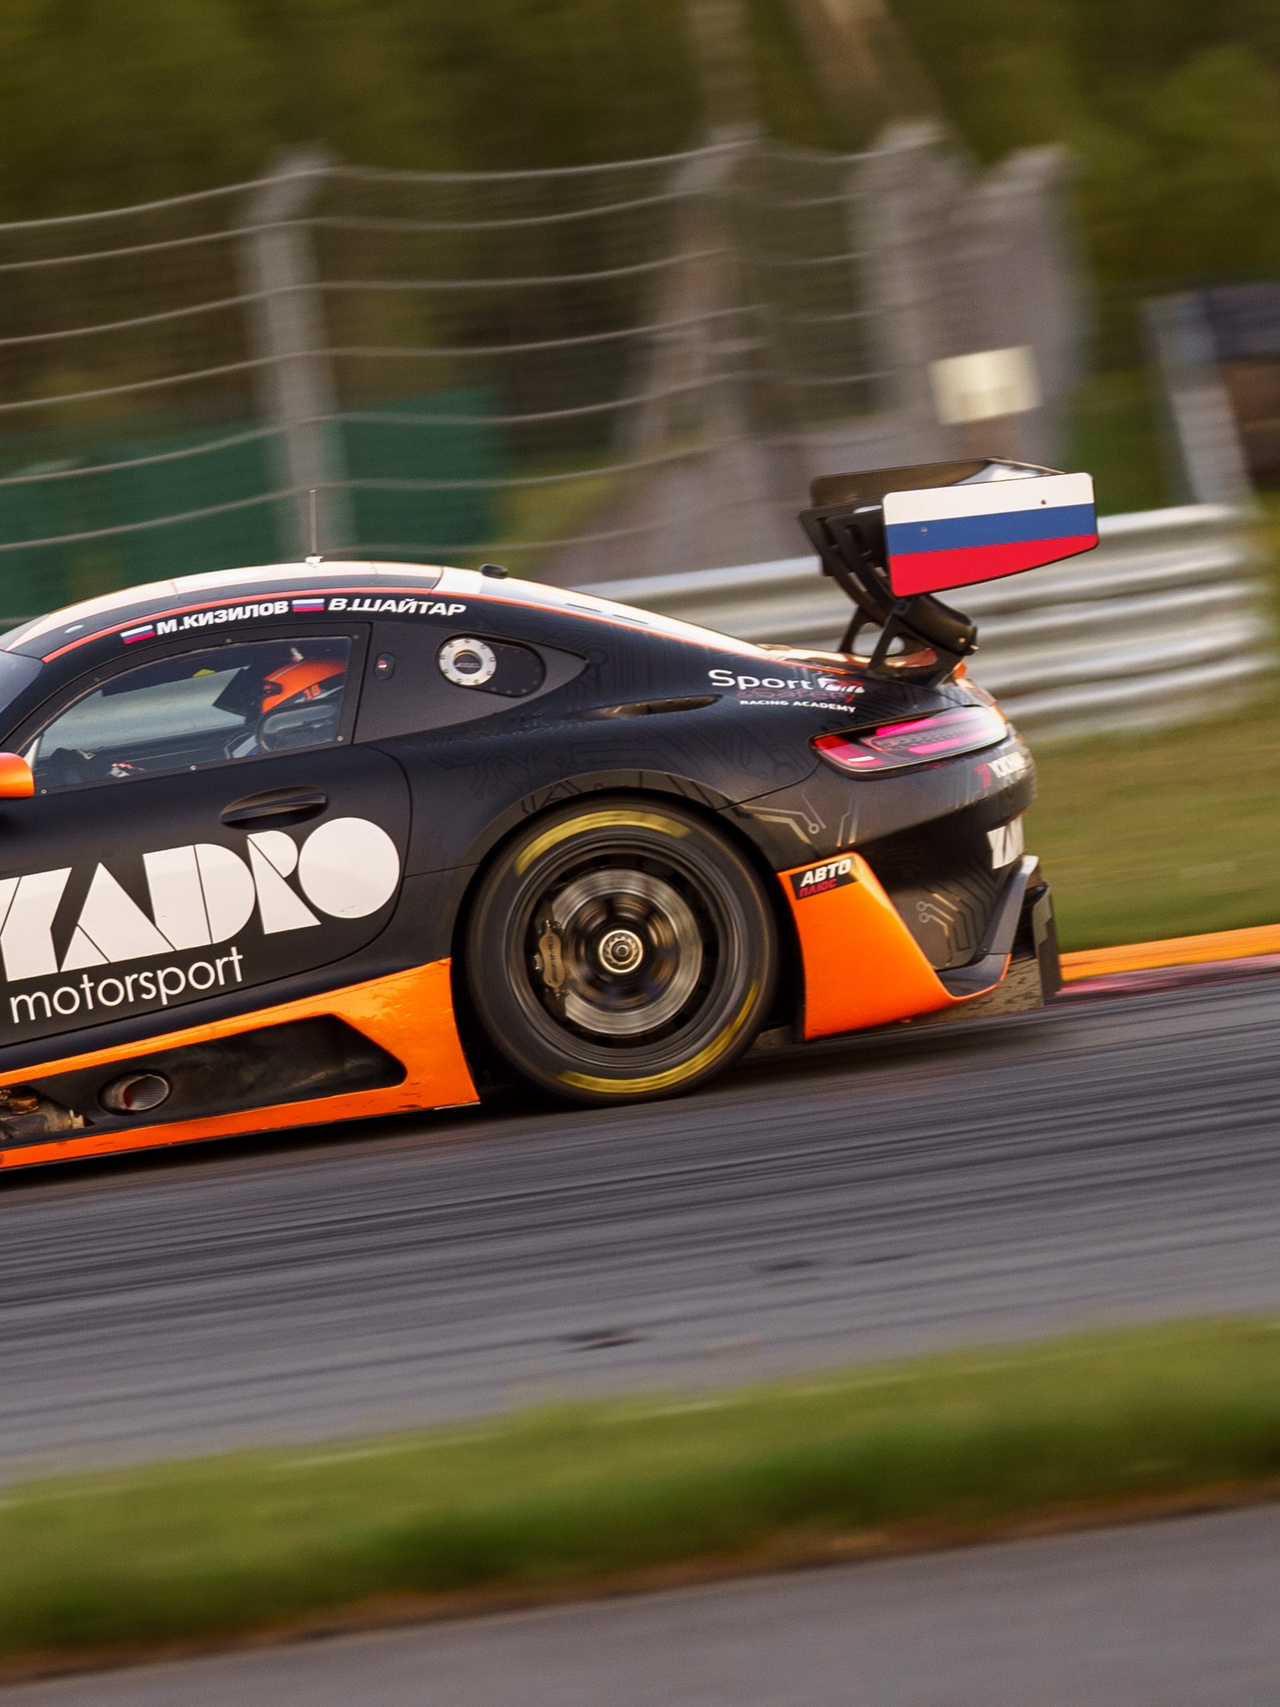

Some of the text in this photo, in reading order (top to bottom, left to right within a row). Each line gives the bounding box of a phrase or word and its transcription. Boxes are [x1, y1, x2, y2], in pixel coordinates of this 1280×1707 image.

[157, 600, 289, 635] М.КИЗИЛОВ
[328, 598, 467, 616] В.ШАЙТАР
[708, 669, 814, 690] Sport
[792, 701, 856, 713] ACADEMY
[800, 858, 852, 887] АВТО
[9, 947, 243, 1025] motorsport
